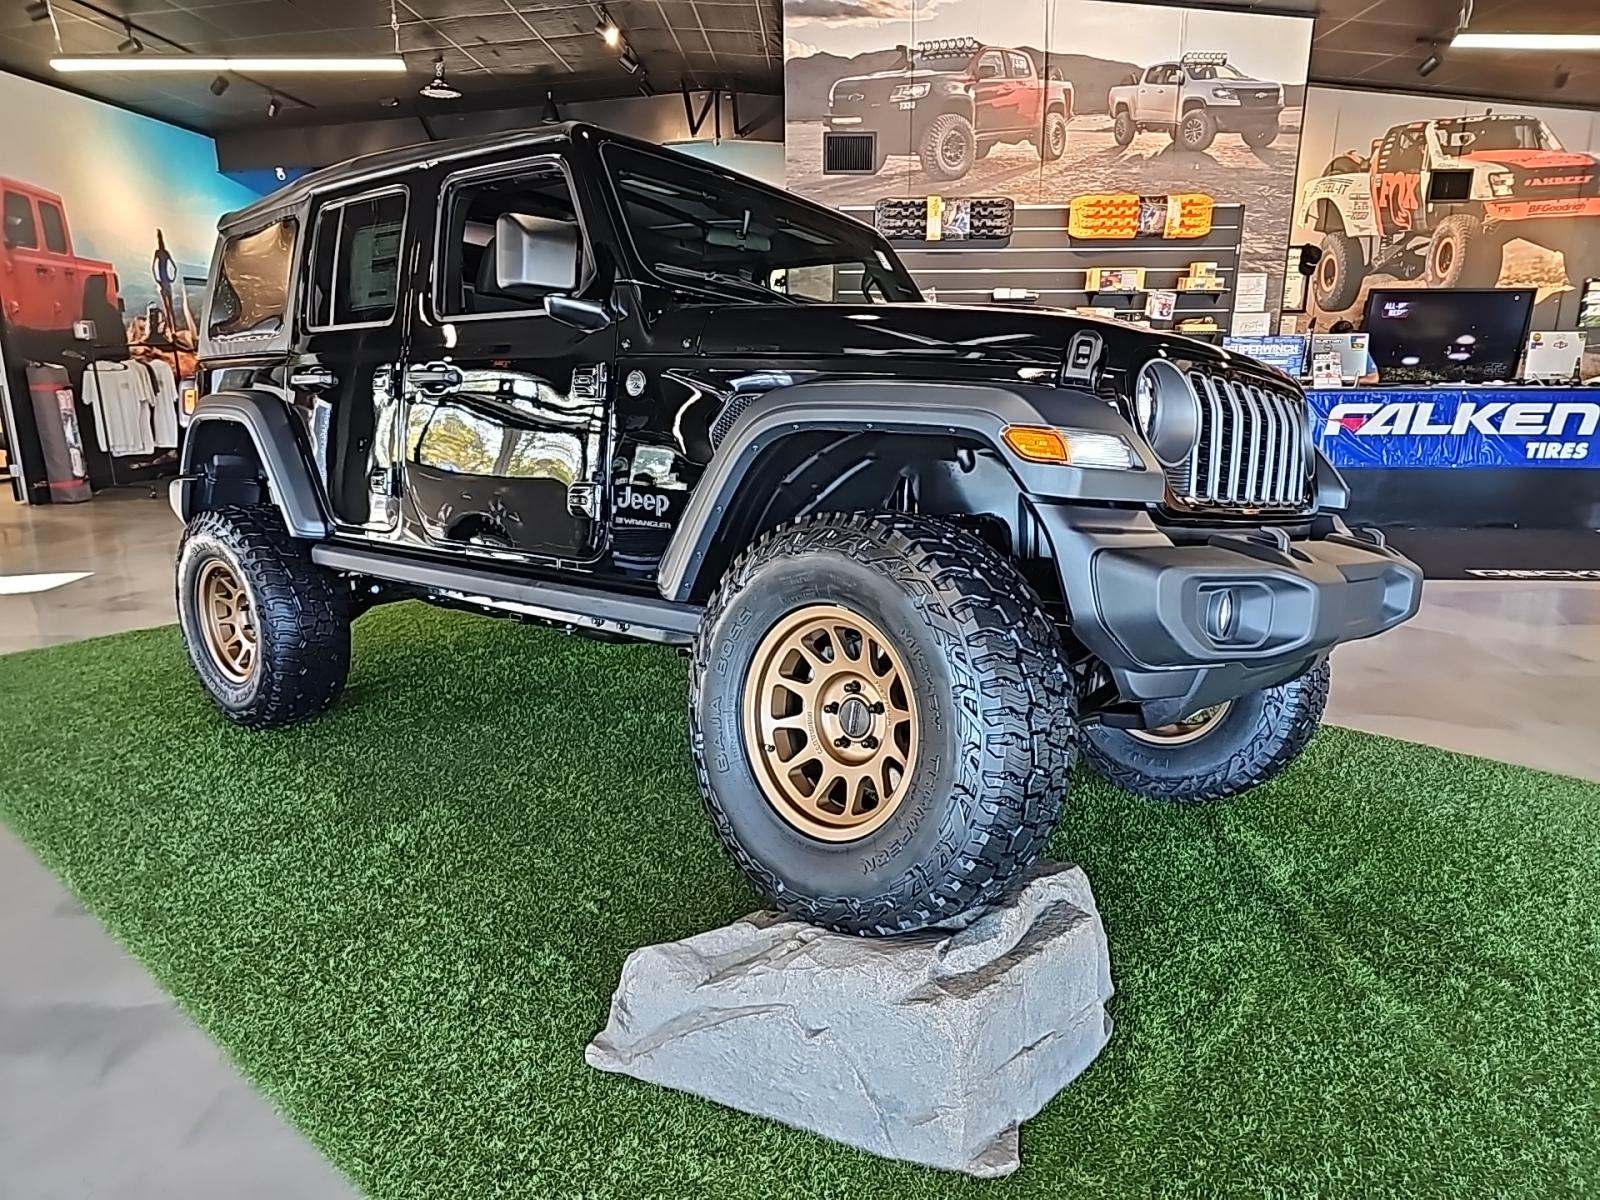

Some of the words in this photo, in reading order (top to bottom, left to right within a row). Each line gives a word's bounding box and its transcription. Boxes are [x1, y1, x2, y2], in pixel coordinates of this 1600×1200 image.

[1379, 171, 1420, 213] FOX
[1528, 203, 1587, 213] BFGoodrich
[1324, 402, 1600, 436] FALKEN
[1525, 442, 1589, 460] TIRES
[617, 486, 670, 517] Jeep
[623, 517, 672, 530] WRANGLER
[716, 606, 752, 677] BOSS
[709, 696, 730, 774] BAJA
